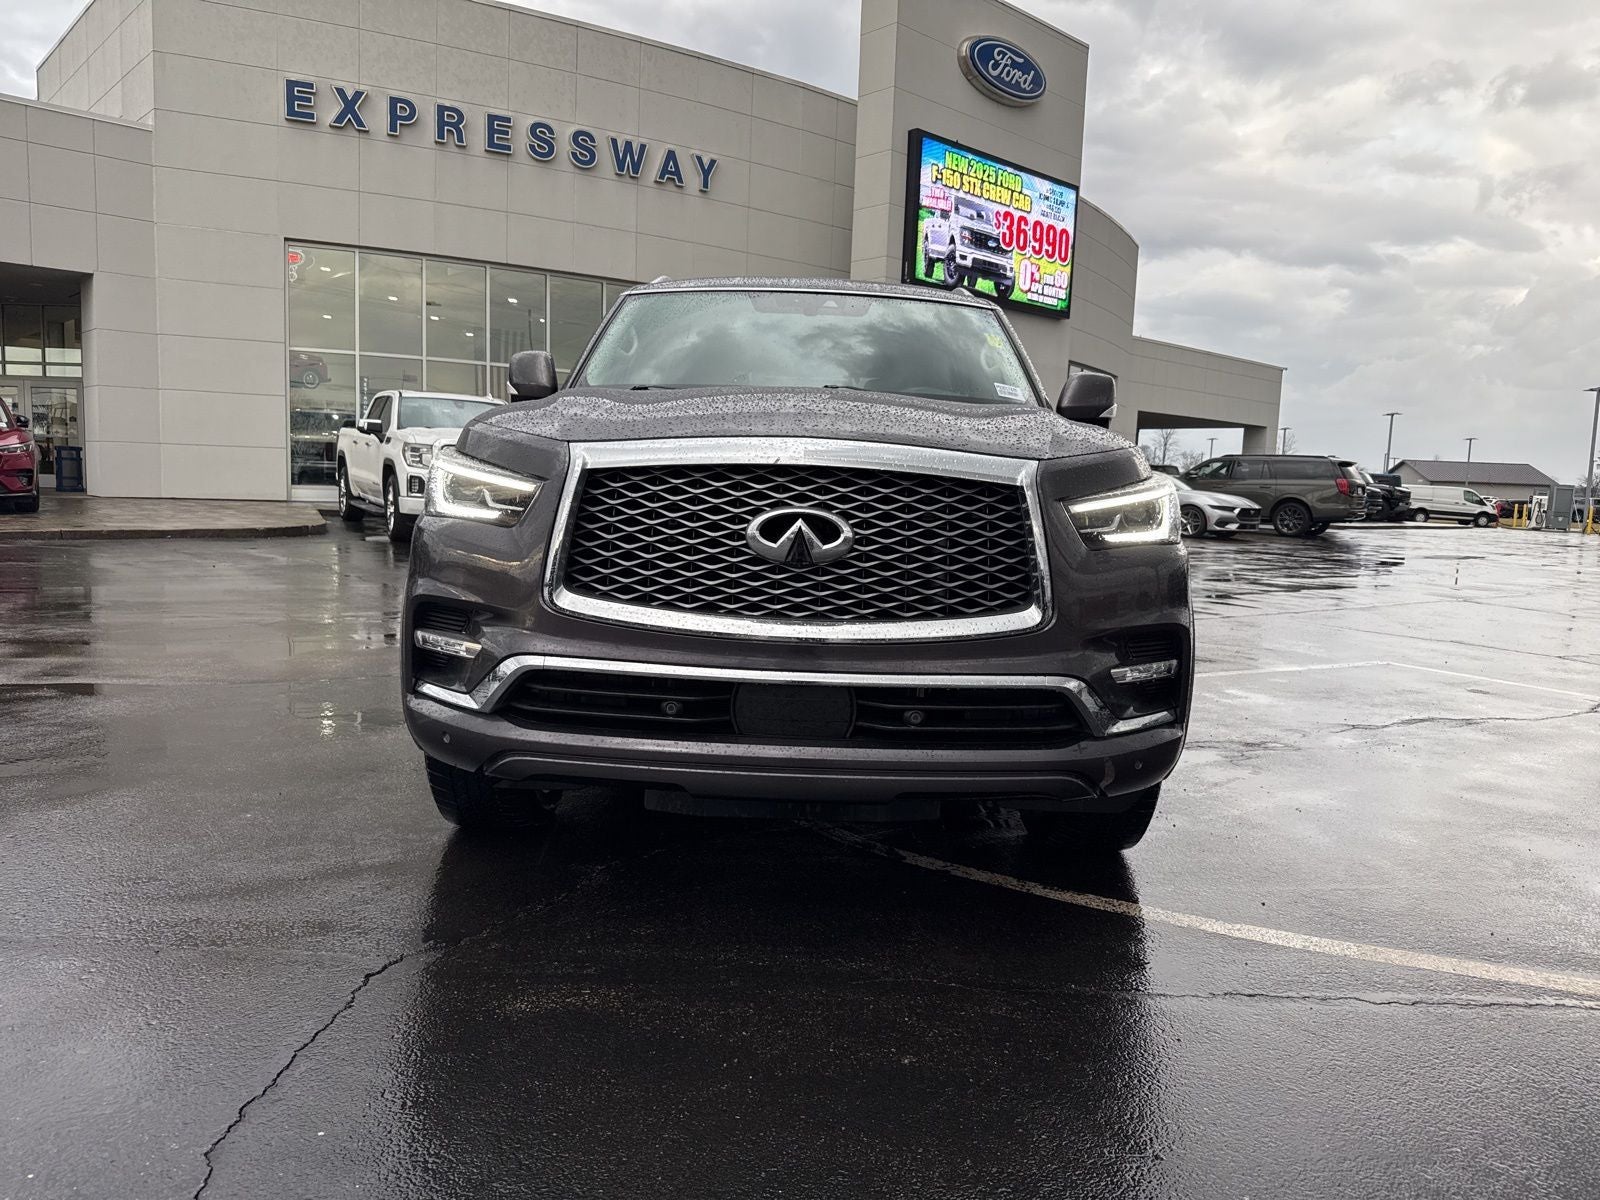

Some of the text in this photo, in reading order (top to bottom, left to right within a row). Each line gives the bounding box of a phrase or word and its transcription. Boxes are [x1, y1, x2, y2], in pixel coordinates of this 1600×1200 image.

[988, 47, 1035, 91] Ford
[284, 77, 719, 192] EXPRESSWAY
[932, 163, 961, 190] F-150
[962, 174, 982, 197] STX
[982, 181, 1012, 206] CREW
[945, 150, 1023, 192] NEW 2025 FORD
